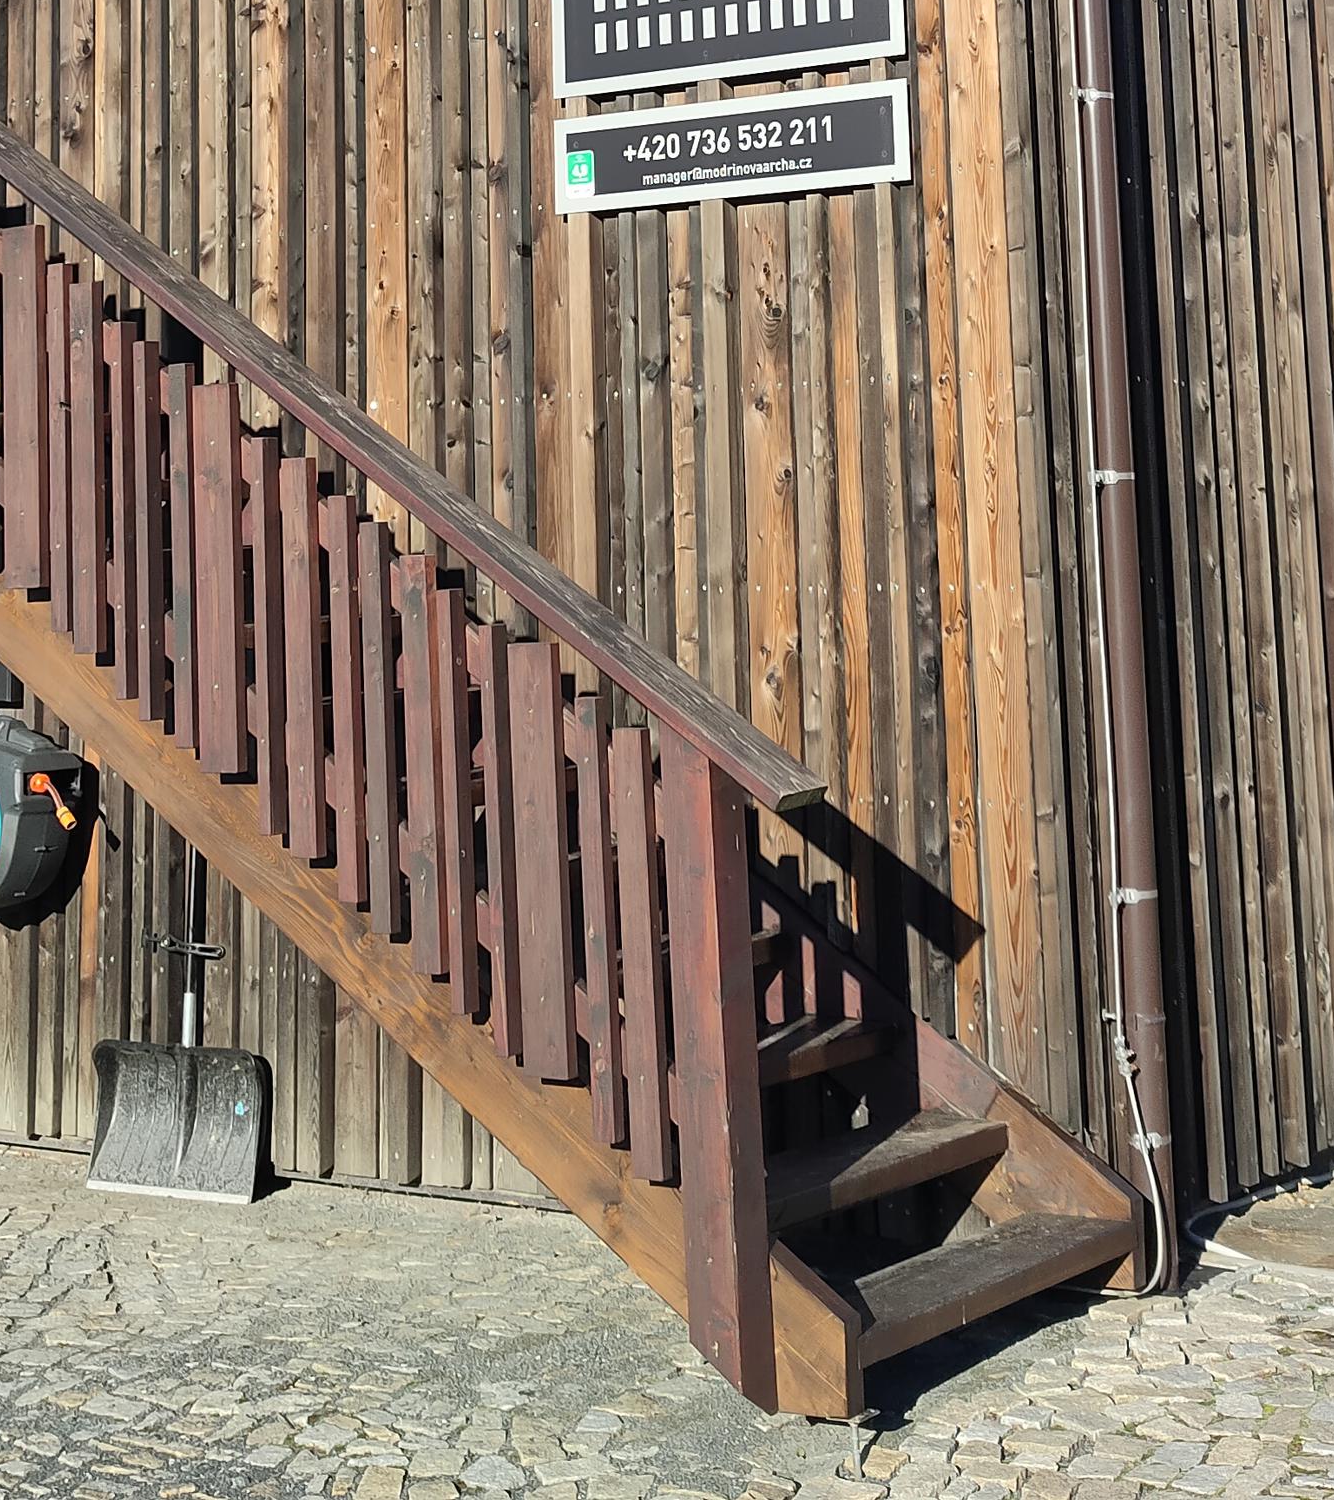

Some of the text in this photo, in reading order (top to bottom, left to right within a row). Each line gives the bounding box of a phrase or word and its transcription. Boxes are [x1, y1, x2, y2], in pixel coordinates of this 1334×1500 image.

[623, 115, 834, 162] +420 736 532 211
[642, 157, 813, 186] manager@modrinovaarcha.cz
